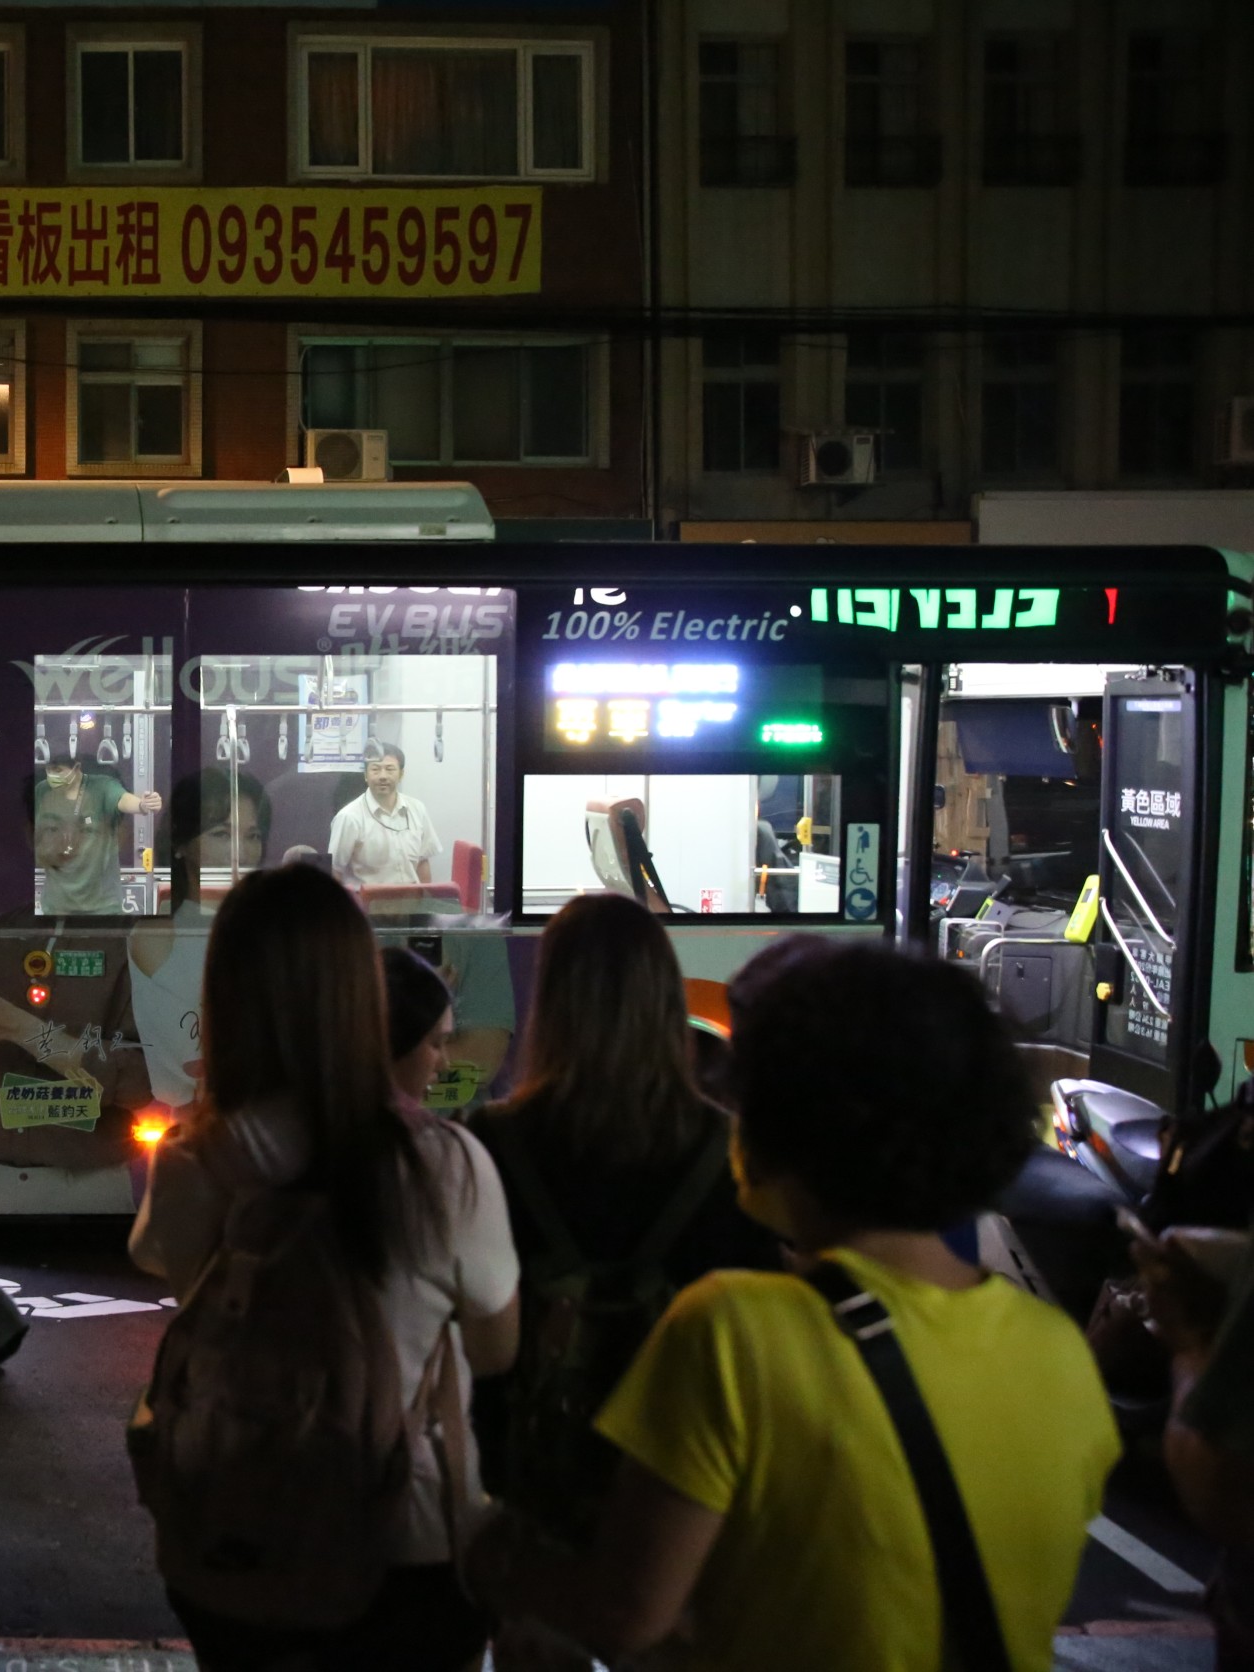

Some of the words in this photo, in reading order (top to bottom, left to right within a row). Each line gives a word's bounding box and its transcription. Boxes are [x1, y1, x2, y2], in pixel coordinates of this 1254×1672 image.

[181, 203, 533, 286] 0935459597
[327, 603, 395, 638] EV
[401, 604, 508, 638] BUS
[542, 611, 643, 641] 100%
[650, 610, 789, 641] Electric
[1120, 788, 1181, 818] 黃色區域
[1130, 816, 1153, 828] YELLOW
[1153, 818, 1170, 830] AREA
[6, 1085, 94, 1101] 虎奶菇養氣飲
[48, 1105, 89, 1118] 藍鈞天
